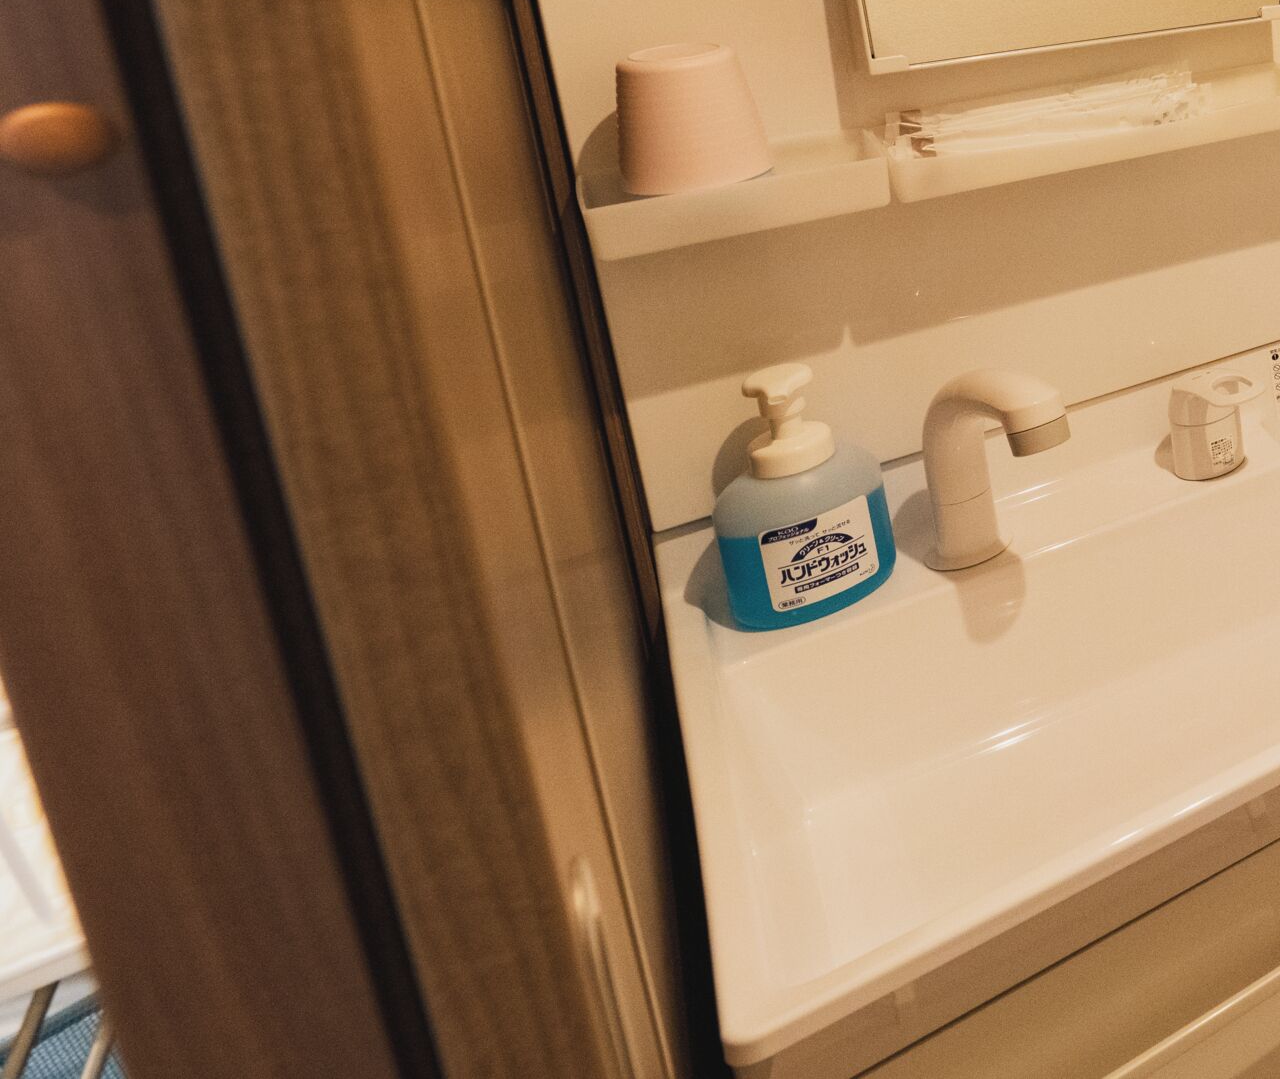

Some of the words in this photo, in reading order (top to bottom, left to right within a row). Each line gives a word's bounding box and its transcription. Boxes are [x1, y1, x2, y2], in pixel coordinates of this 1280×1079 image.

[767, 527, 809, 542] プロフェッショナル
[817, 545, 830, 554] F1
[780, 542, 867, 584] ハンドウォッシュ
[781, 598, 803, 608] 業務用
